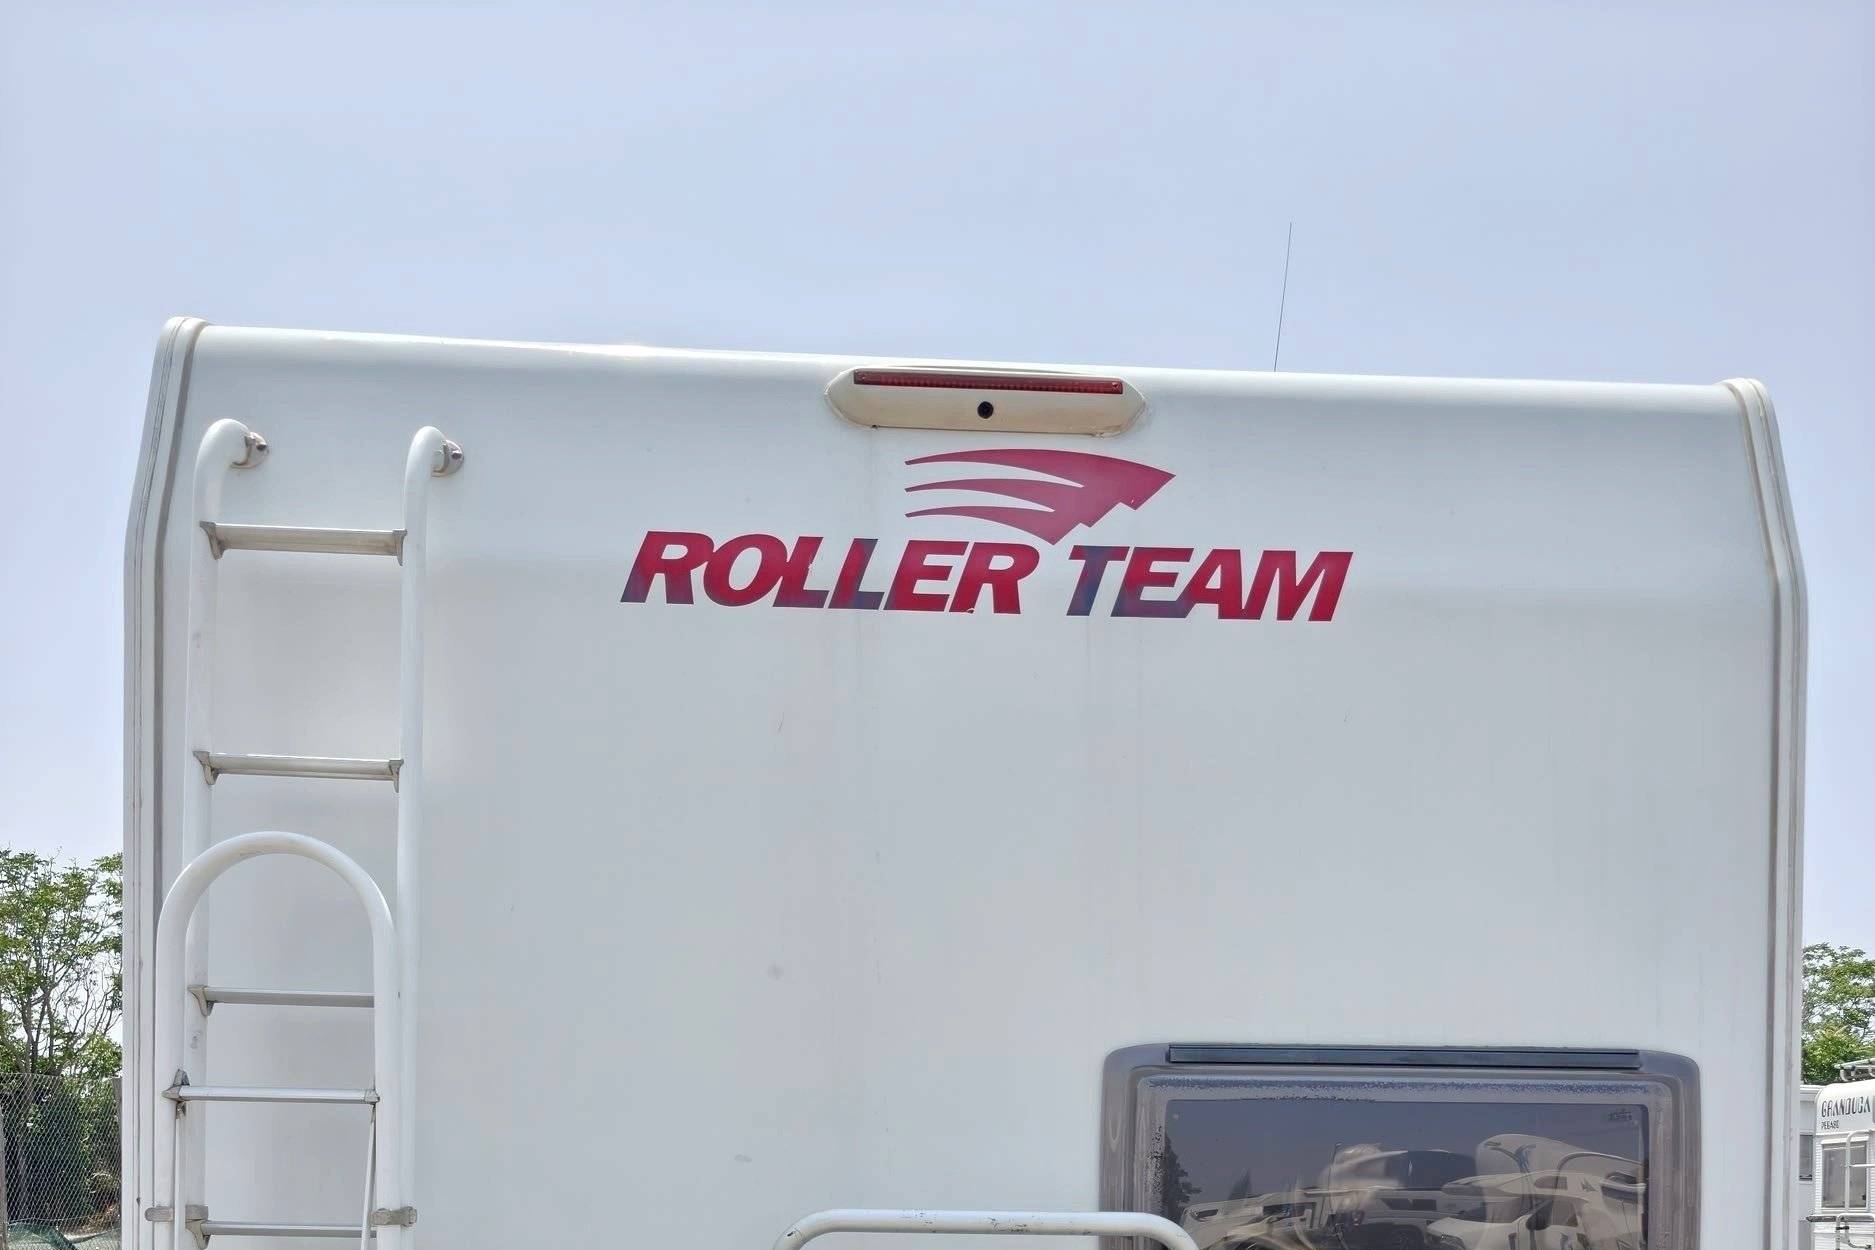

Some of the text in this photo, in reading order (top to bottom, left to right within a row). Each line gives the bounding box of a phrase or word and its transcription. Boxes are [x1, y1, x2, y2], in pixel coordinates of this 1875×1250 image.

[620, 530, 1354, 622] ROLLER TEAM
[1821, 1096, 1871, 1117] GRANDUCA
